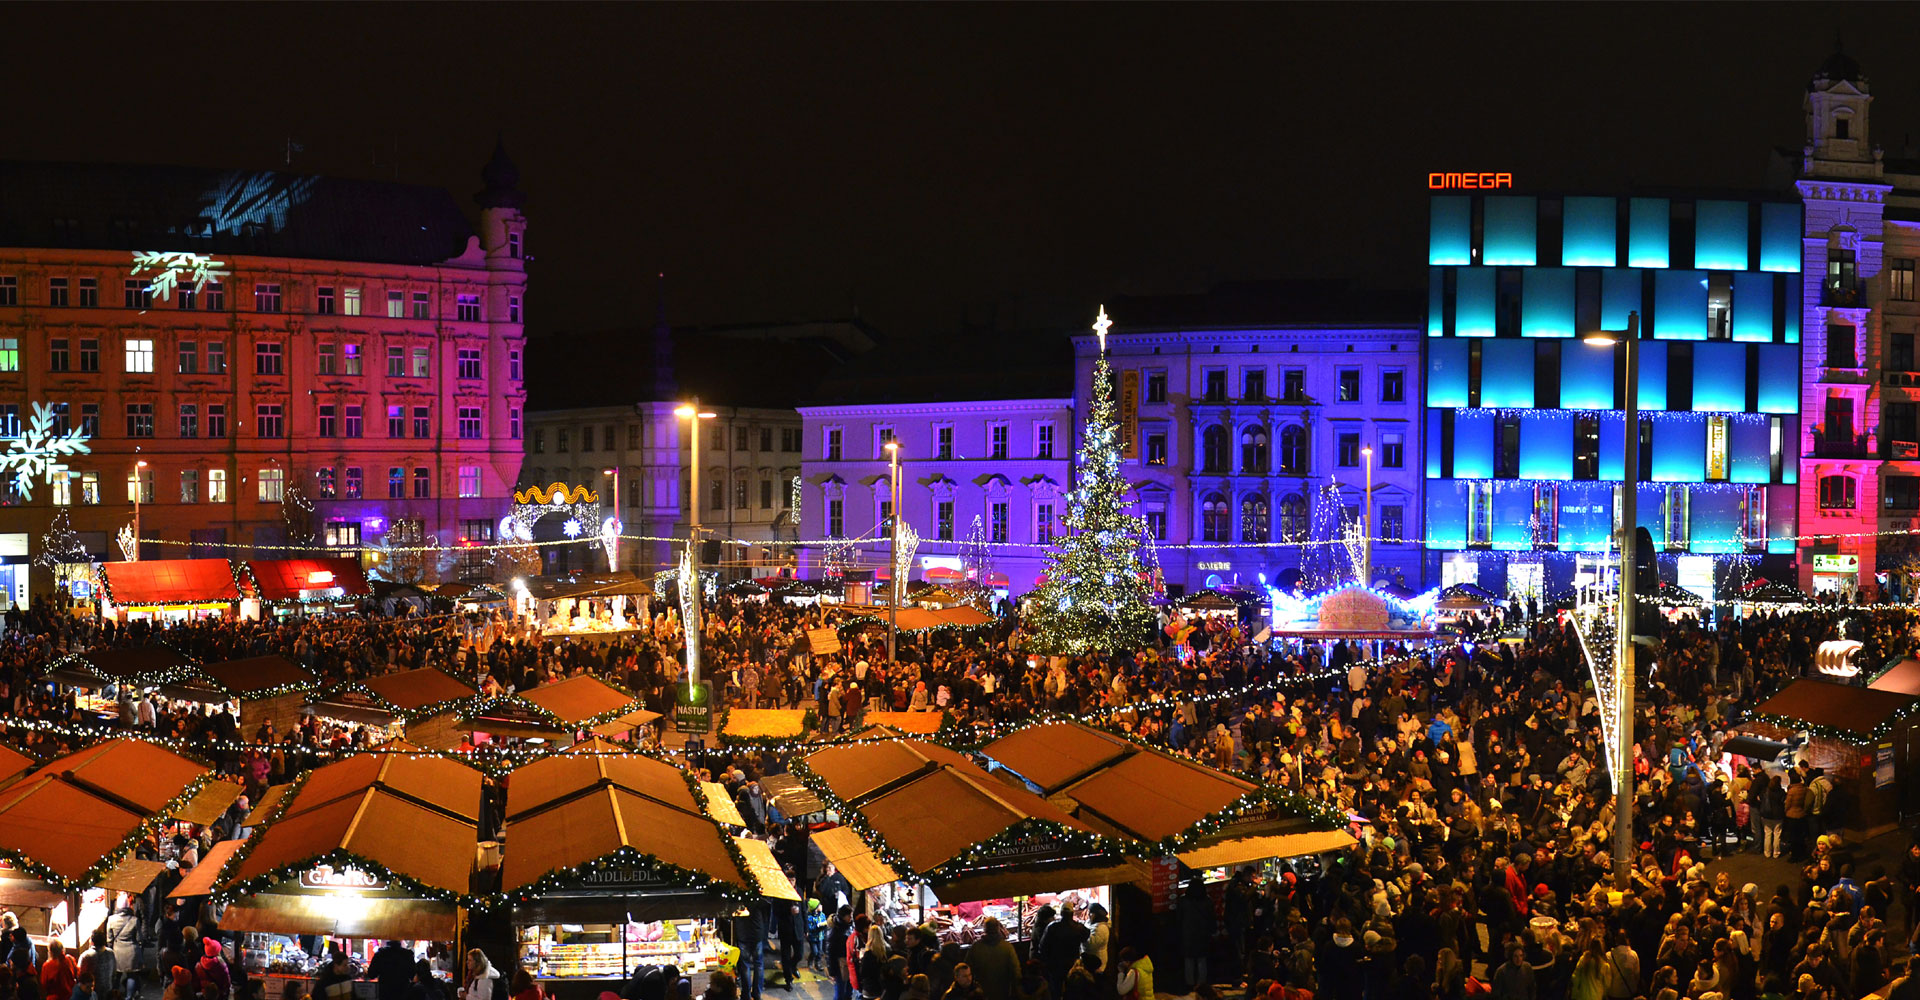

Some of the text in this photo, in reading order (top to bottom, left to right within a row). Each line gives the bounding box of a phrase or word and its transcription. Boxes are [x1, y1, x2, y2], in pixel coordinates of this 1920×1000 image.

[1428, 172, 1512, 189] OMEGA
[677, 704, 707, 716] NÁSTUP
[308, 869, 378, 886] GASTRO
